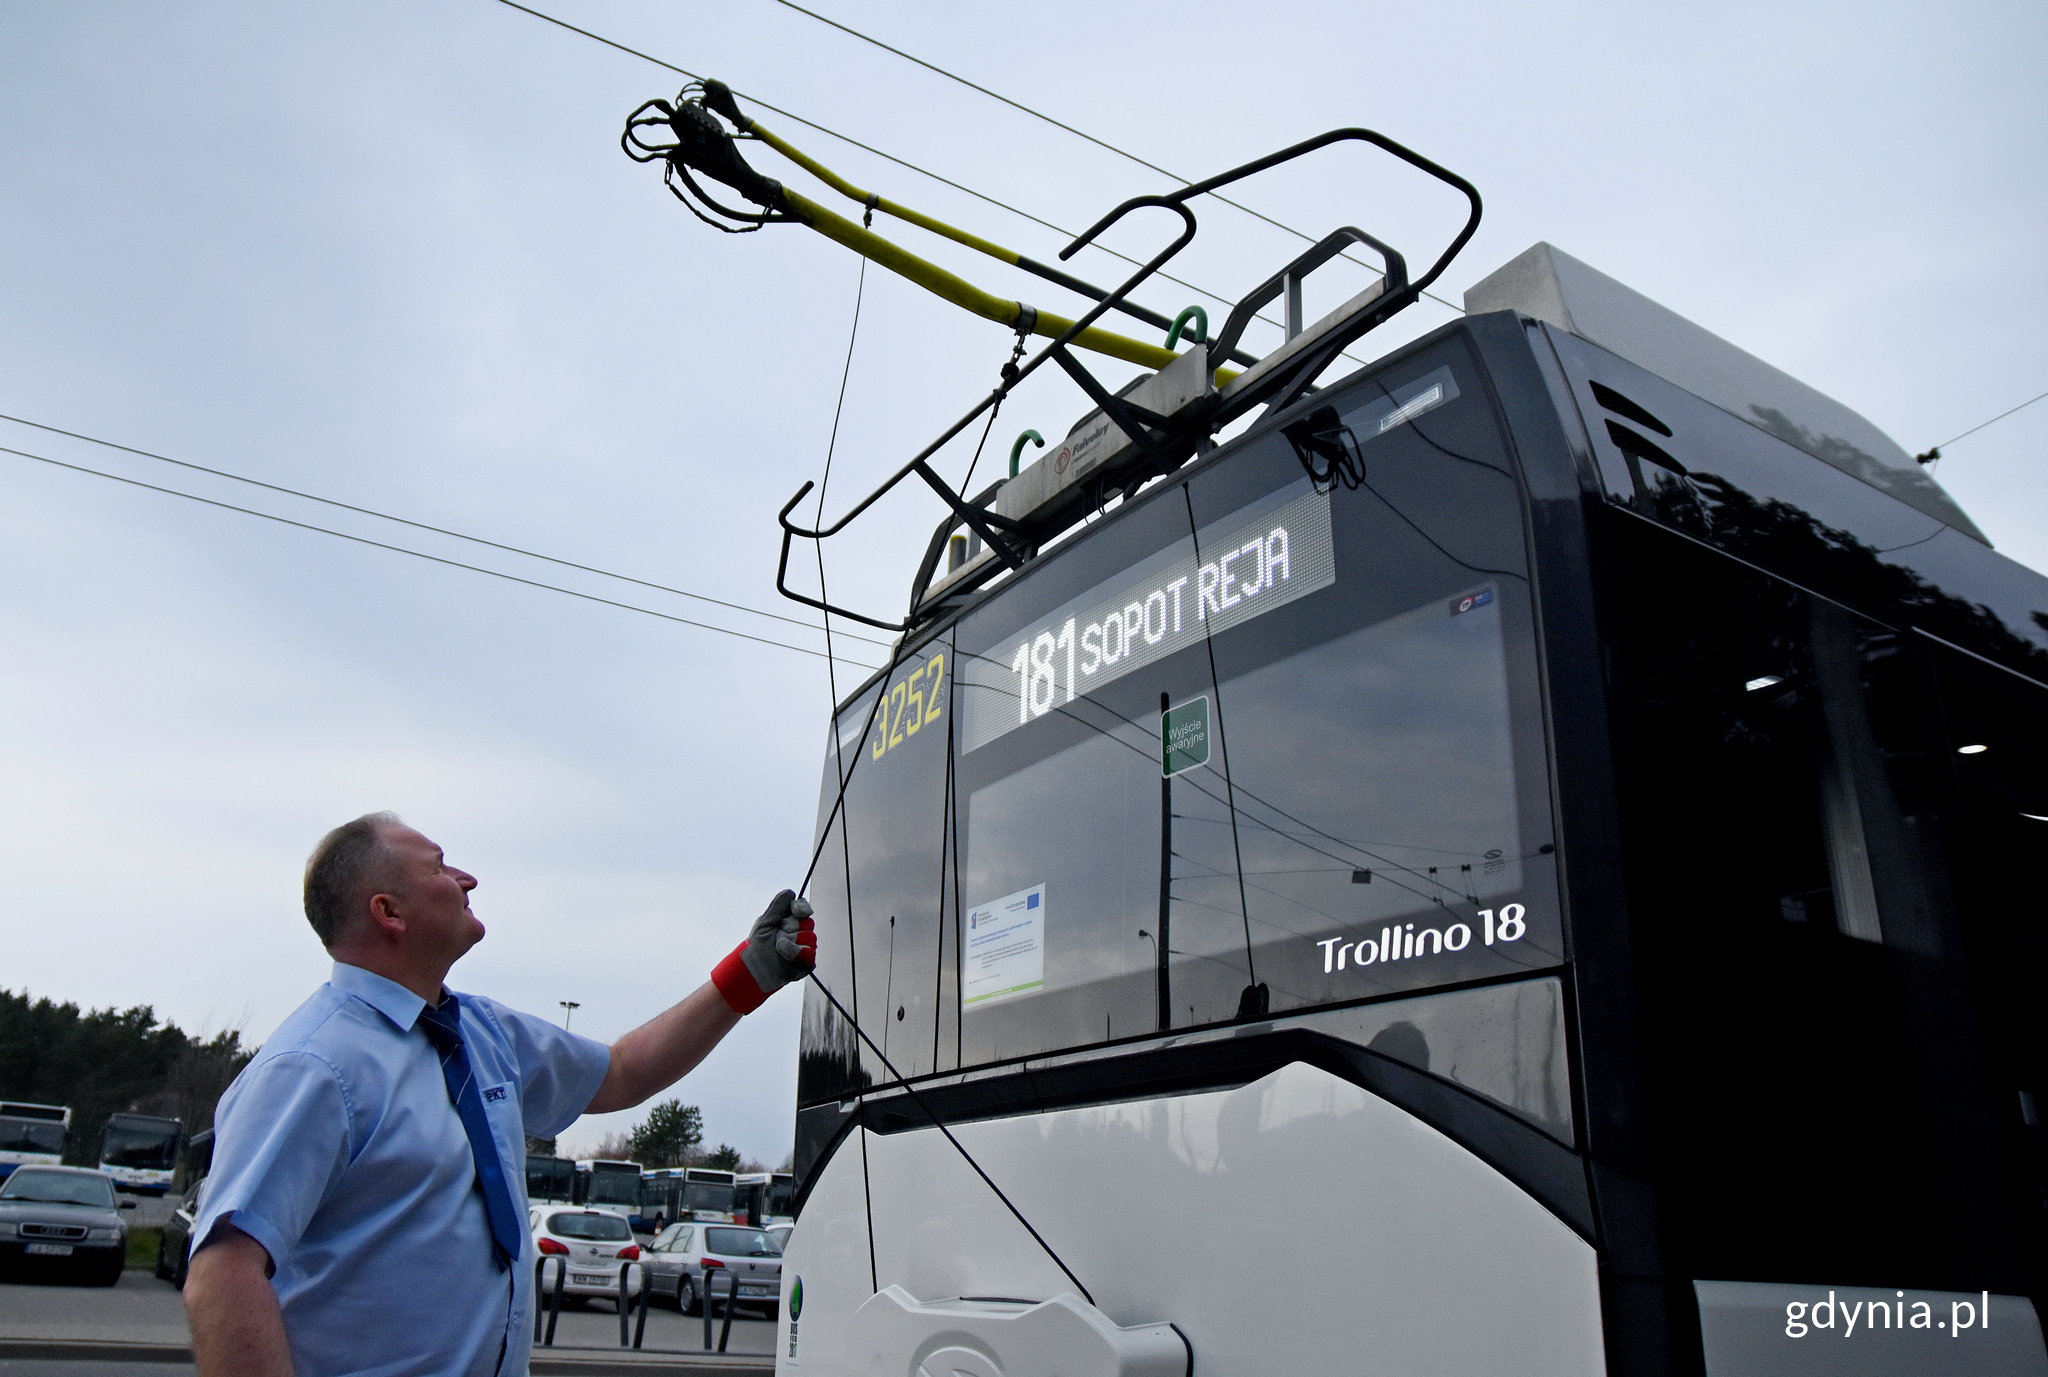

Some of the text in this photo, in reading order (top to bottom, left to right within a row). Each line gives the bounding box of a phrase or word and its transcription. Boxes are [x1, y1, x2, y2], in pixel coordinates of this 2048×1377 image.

[1012, 527, 1290, 724] 181 SOPOT REJA
[872, 653, 944, 760] 3252
[1168, 720, 1202, 740] Wyjście
[1166, 732, 1205, 754] awaryjne
[1316, 903, 1527, 974] Trollino 18
